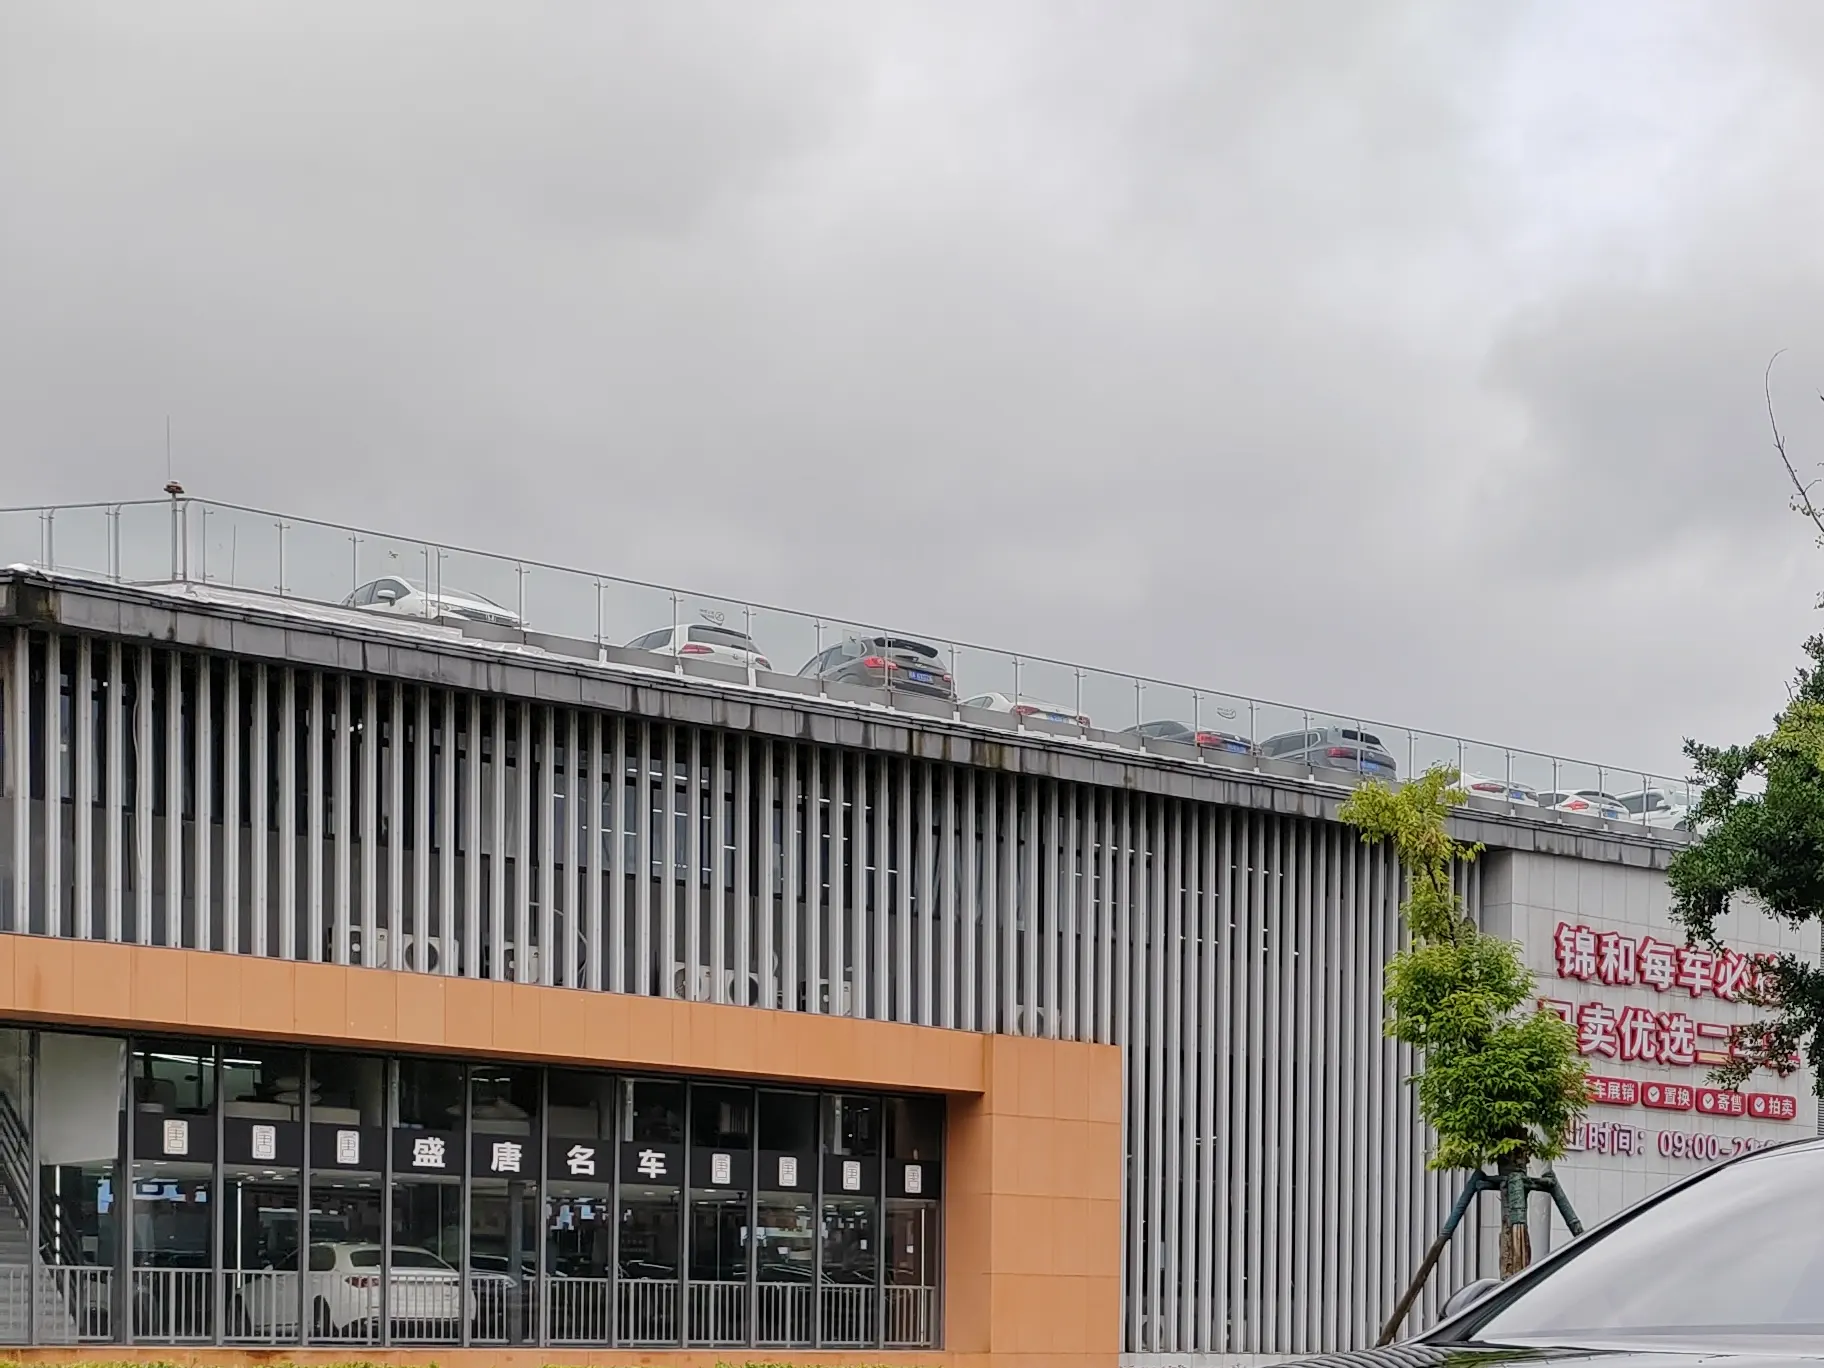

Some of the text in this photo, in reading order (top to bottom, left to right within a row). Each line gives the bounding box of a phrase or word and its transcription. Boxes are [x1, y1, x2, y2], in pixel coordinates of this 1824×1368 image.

[1555, 922, 1782, 1004] 锦和每车必
[1538, 998, 1801, 1069] 卖优选二
[1663, 1087, 1691, 1107] 置换
[1717, 1093, 1742, 1112] 寄售
[1768, 1097, 1794, 1117] 拍卖
[412, 1136, 667, 1179] 盛唐名车
